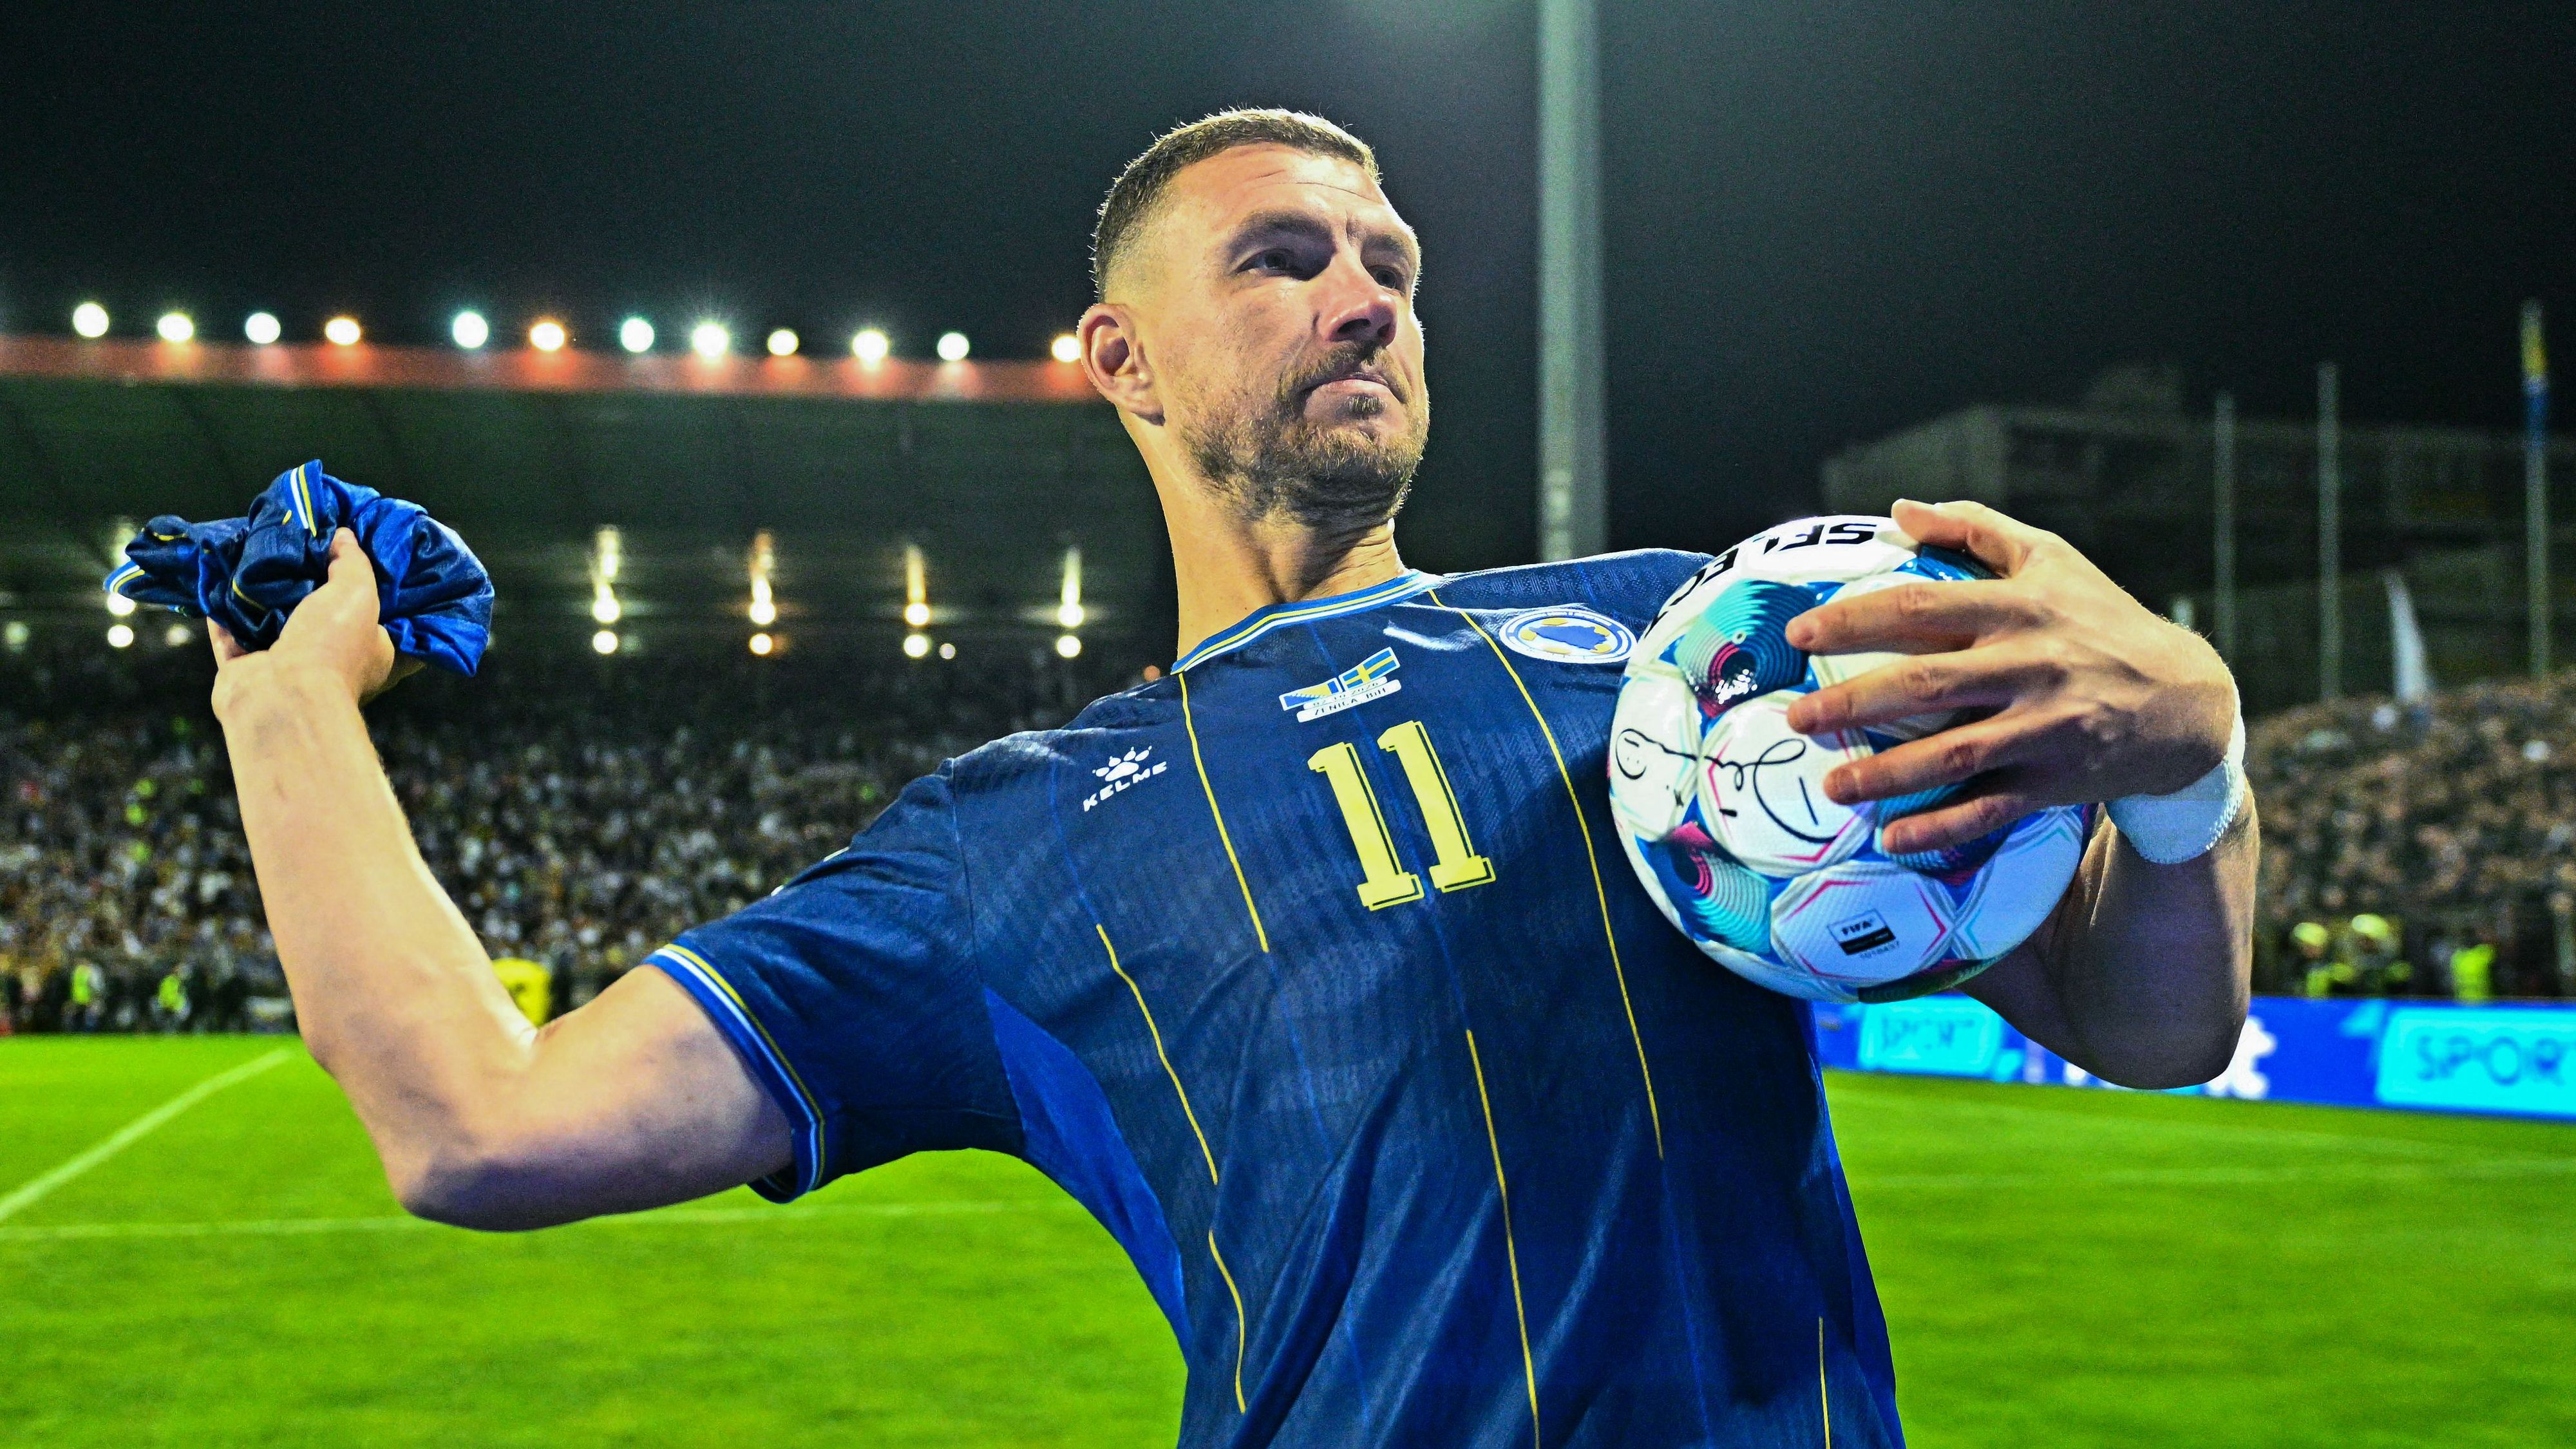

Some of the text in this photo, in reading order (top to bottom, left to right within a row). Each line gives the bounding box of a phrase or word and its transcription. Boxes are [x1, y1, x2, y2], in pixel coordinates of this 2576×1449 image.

[1644, 523, 1877, 639] SELEC
[1083, 761, 1167, 812] KELME
[1307, 721, 1496, 911] 11
[1842, 920, 1872, 936] FIFA
[2416, 1034, 2576, 1088] SPOR
